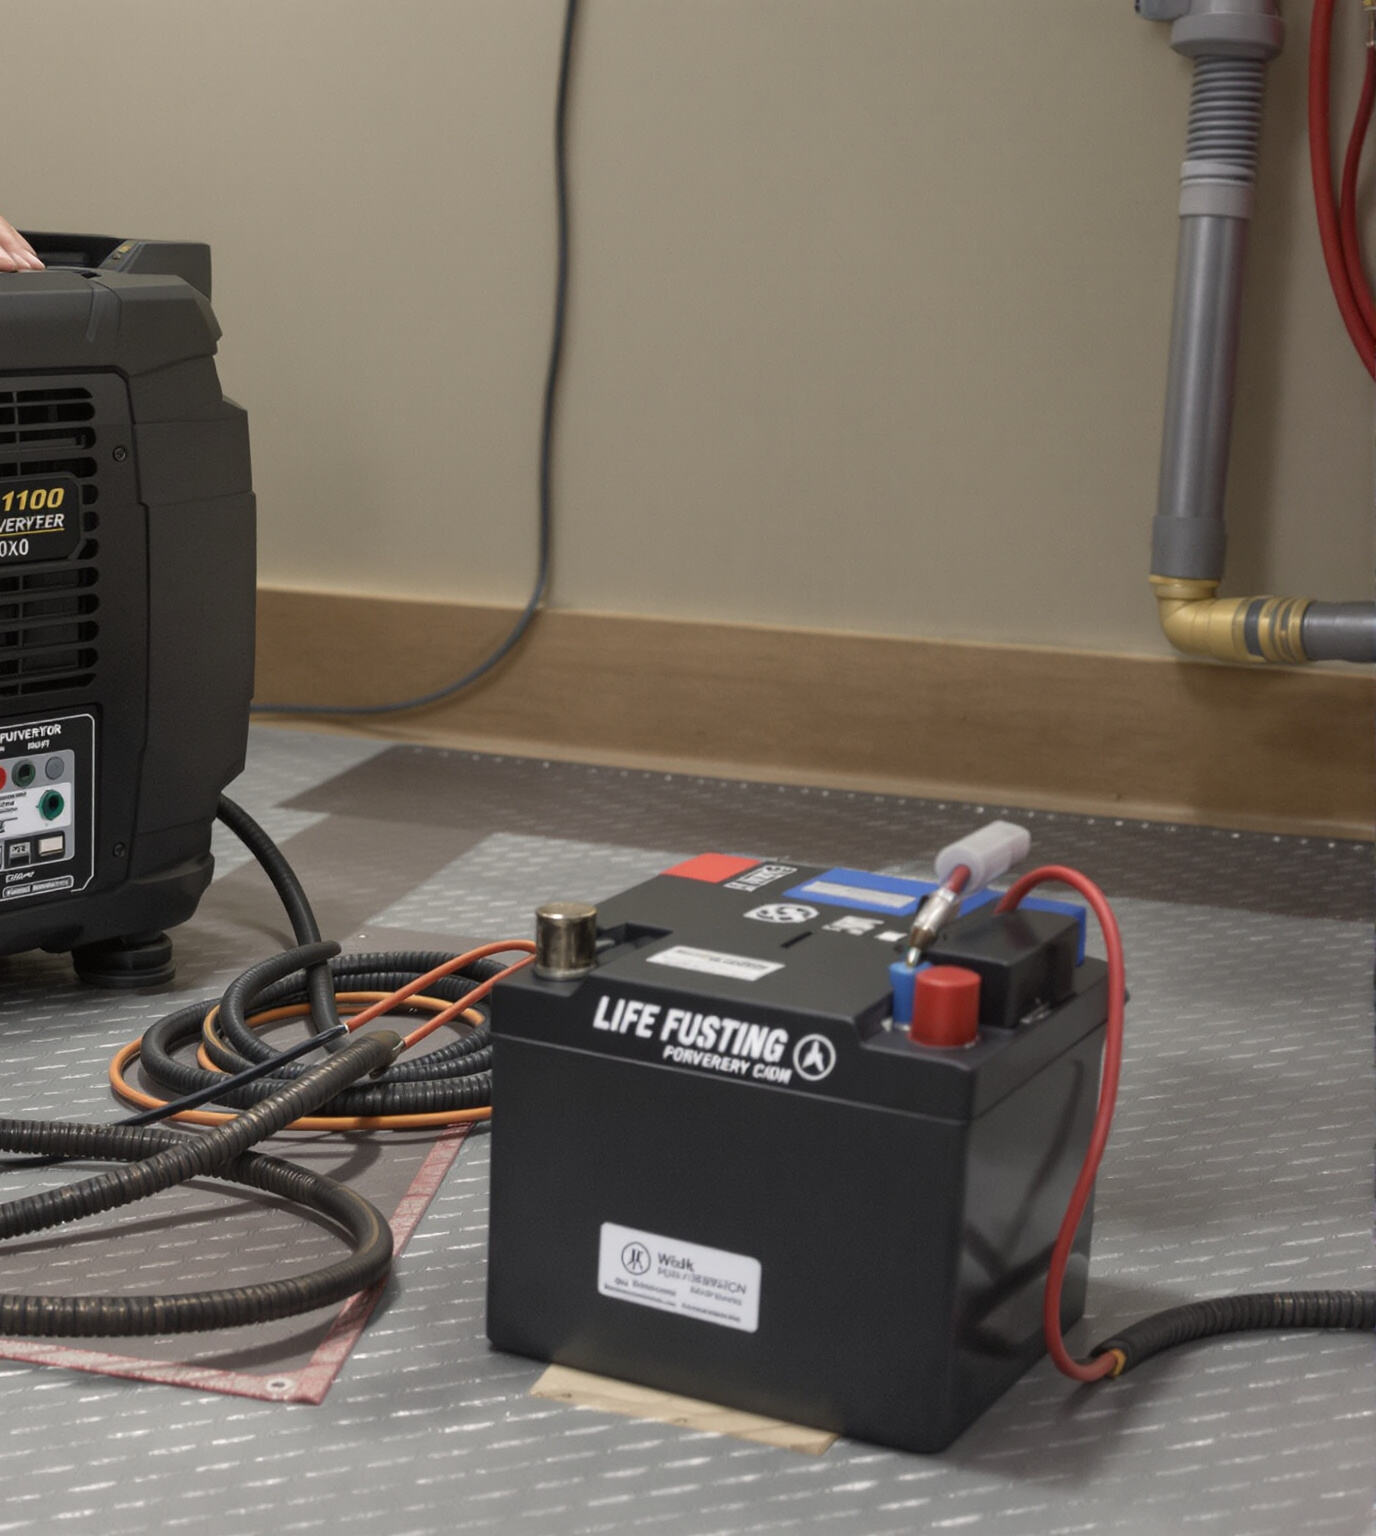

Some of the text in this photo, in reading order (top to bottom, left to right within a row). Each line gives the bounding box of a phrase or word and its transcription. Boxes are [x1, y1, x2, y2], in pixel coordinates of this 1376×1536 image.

[2, 487, 64, 512] 1100
[592, 995, 789, 1063] LIFE FUSTING
